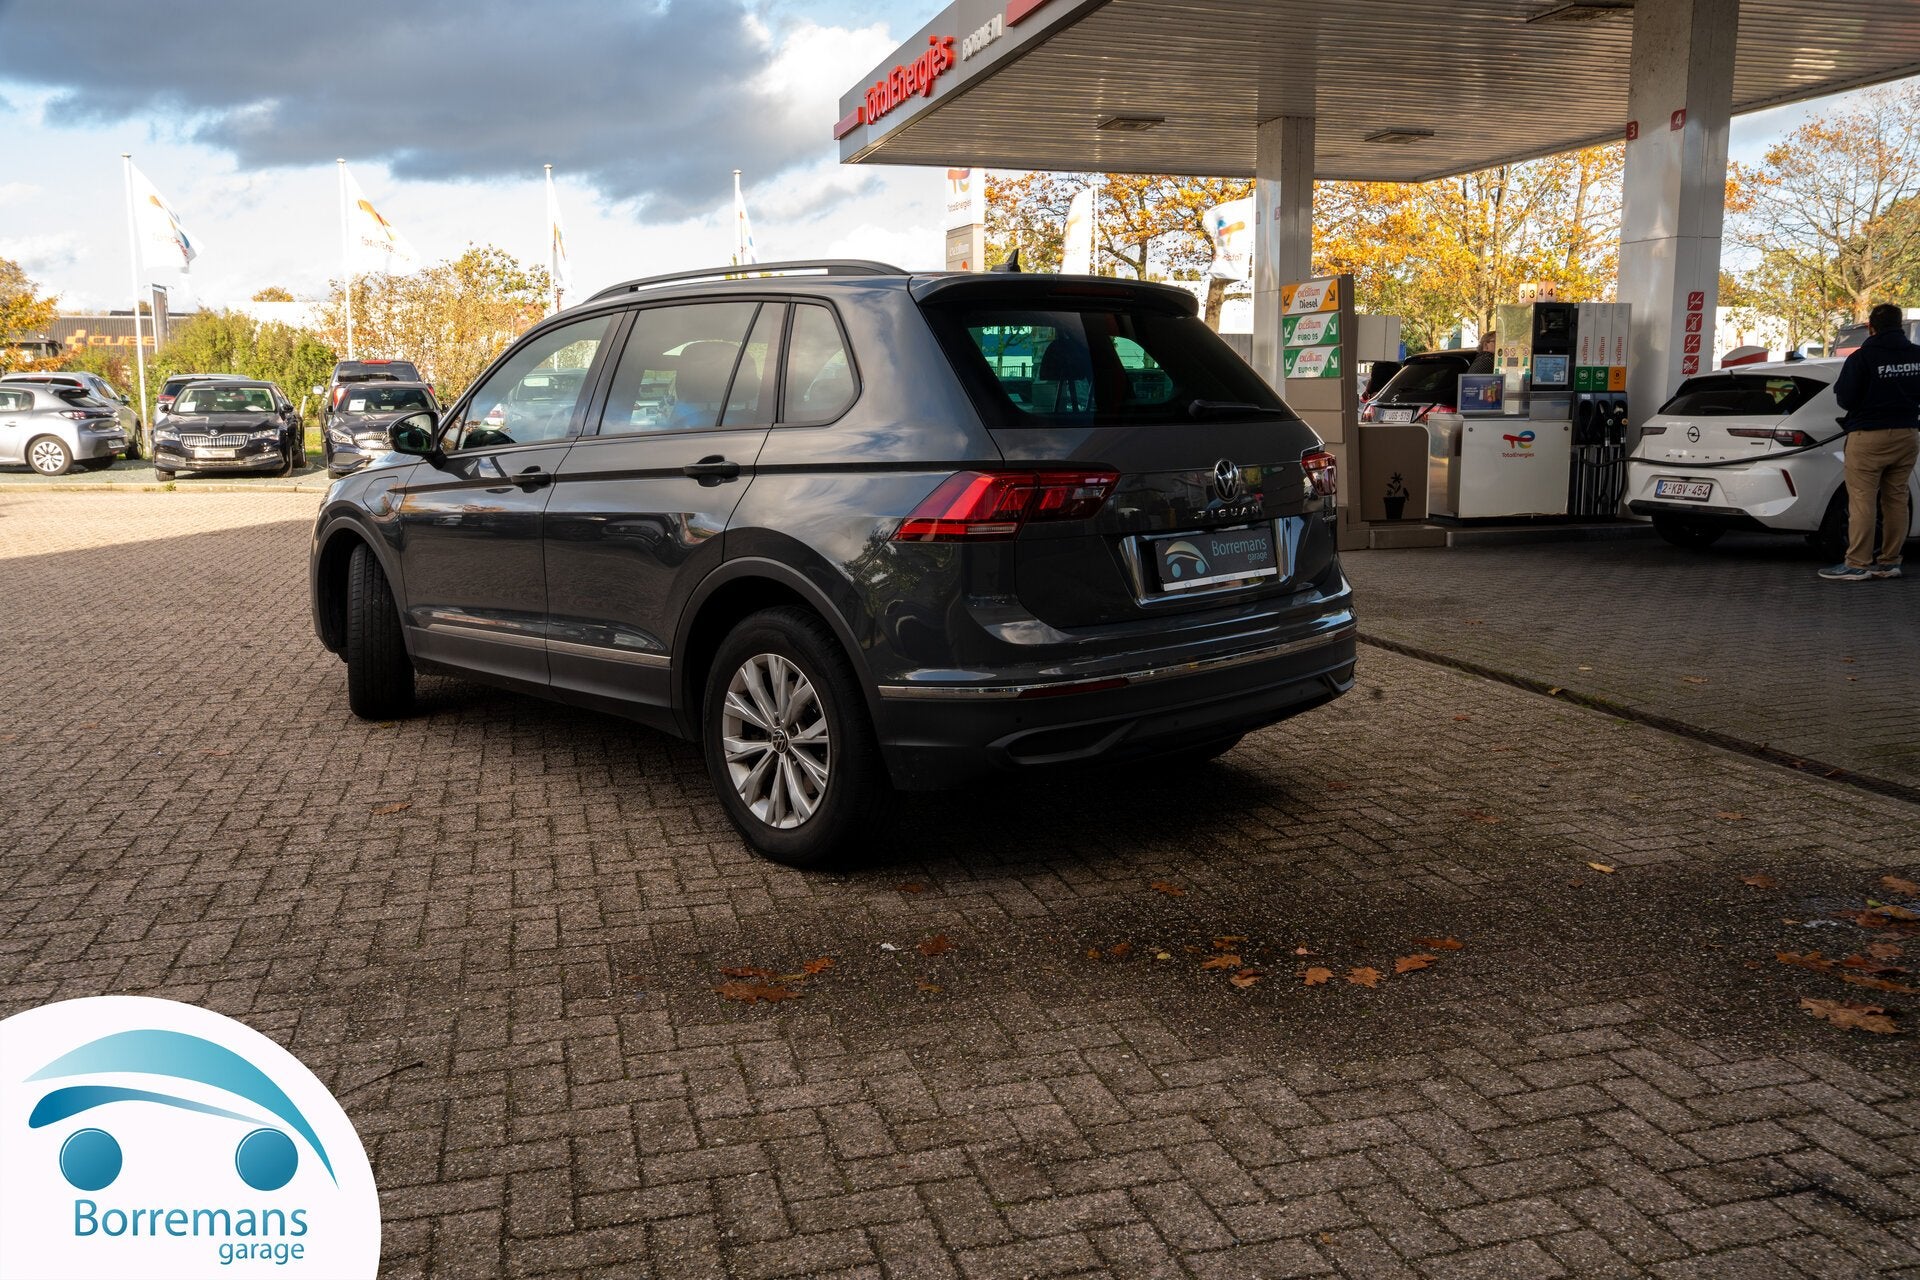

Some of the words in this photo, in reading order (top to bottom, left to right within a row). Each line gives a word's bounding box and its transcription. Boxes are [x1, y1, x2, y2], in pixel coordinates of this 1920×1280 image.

[864, 35, 956, 125] TotalEnergies
[1675, 113, 1682, 126] 4
[1630, 125, 1636, 137] 3
[1520, 289, 1525, 298] 3
[1529, 289, 1535, 298] 3
[1538, 288, 1544, 296] 4
[1547, 288, 1553, 297] 4
[1299, 298, 1318, 309] Diesel
[1878, 362, 1920, 375] FALCON
[1502, 451, 1535, 459] TotalEnergies
[1197, 505, 1259, 519] TIGUAN
[1211, 536, 1268, 557] Borremans
[1247, 550, 1268, 564] garage
